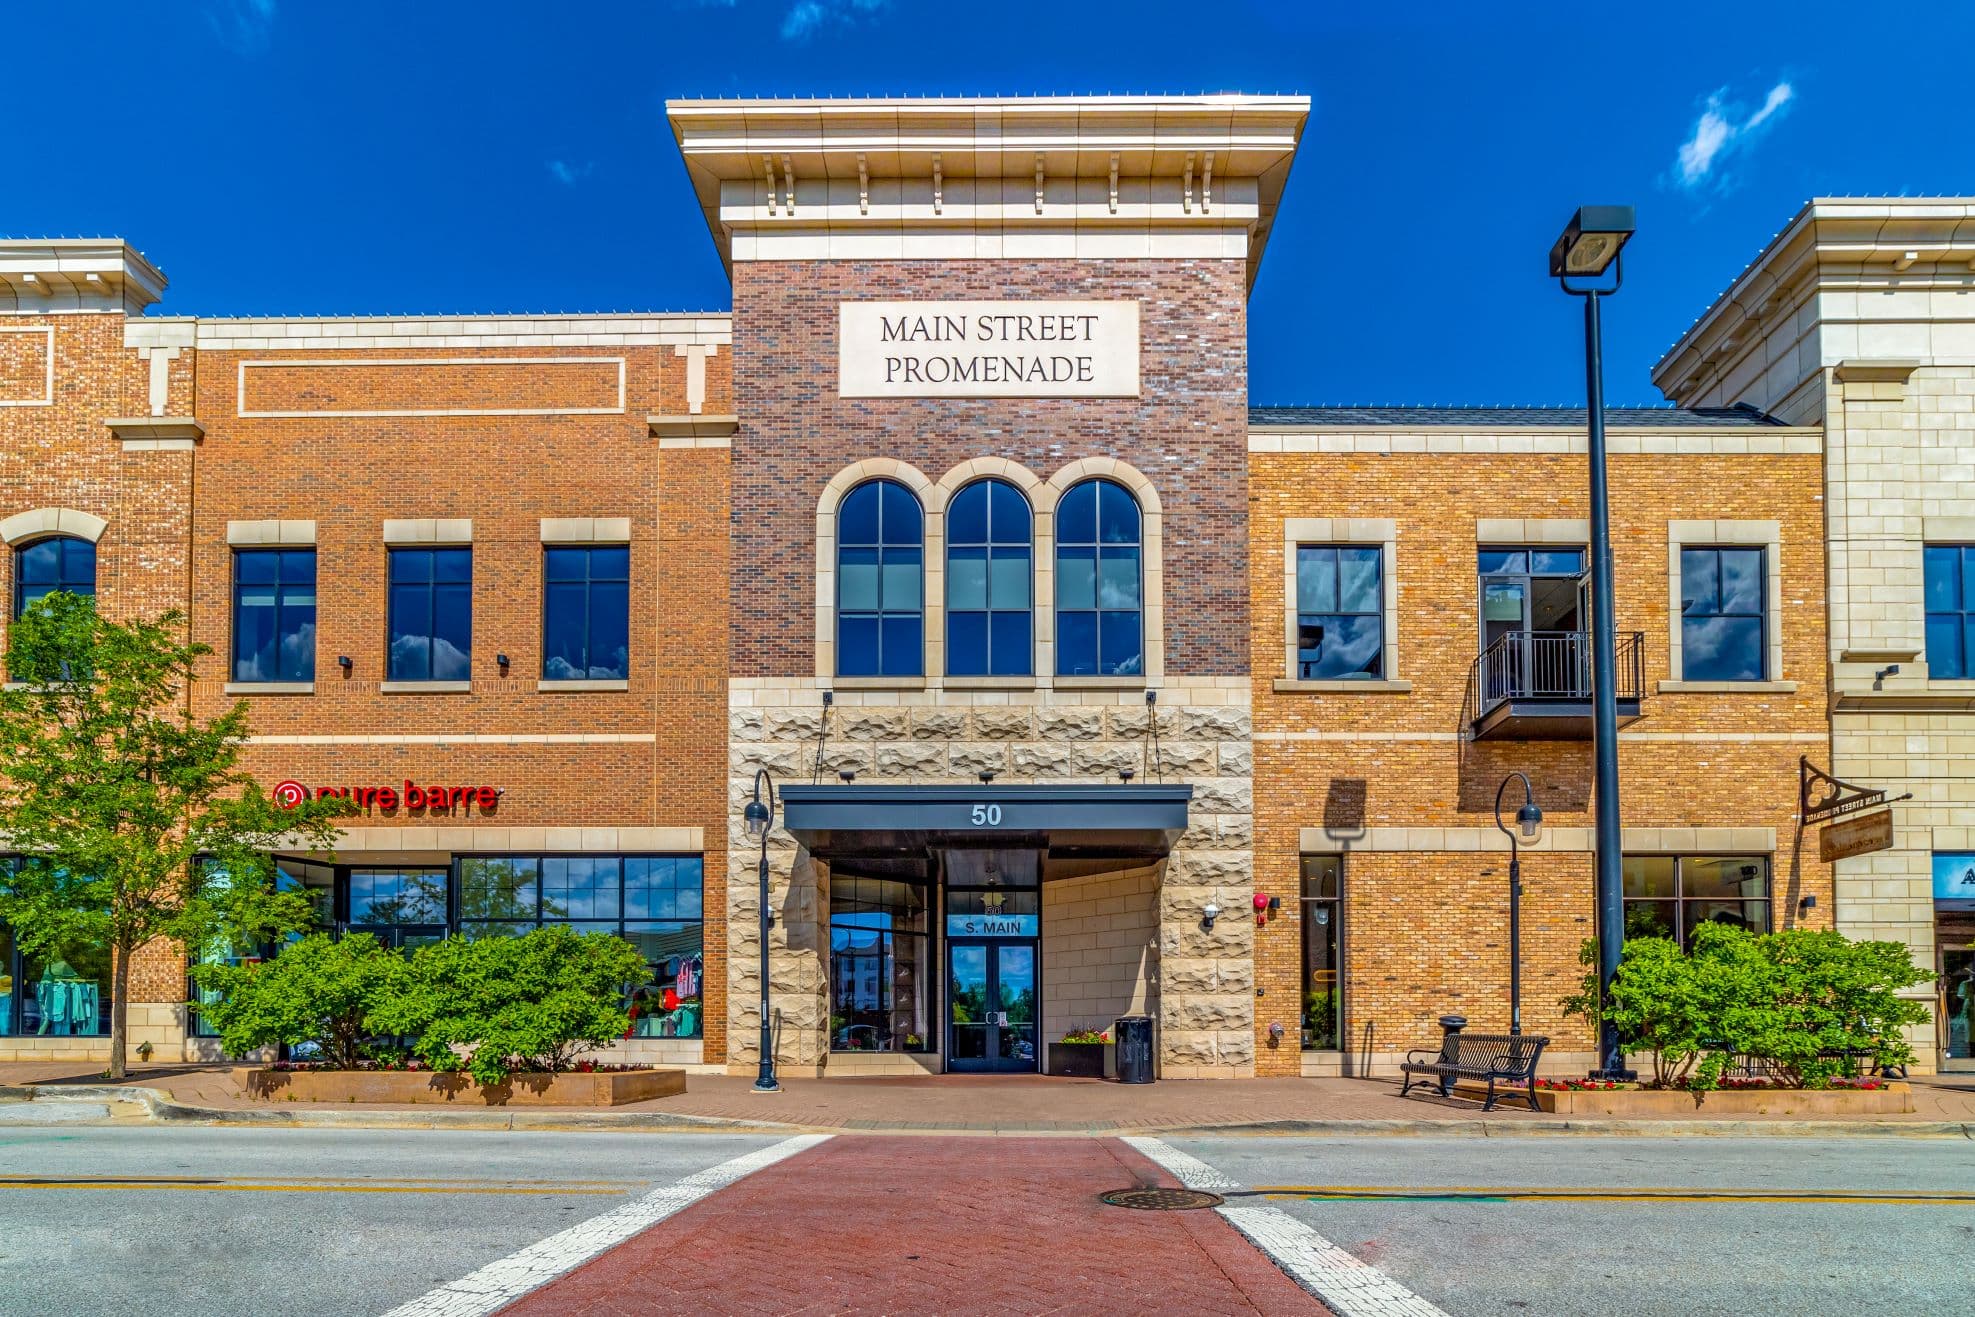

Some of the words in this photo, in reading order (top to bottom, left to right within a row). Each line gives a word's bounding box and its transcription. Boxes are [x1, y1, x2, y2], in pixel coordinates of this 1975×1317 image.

[880, 315, 967, 342] MAIN
[977, 315, 1099, 342] STREET
[884, 356, 1094, 383] PROMENADE
[404, 779, 496, 809] barre
[971, 804, 1002, 826] 50
[985, 905, 1002, 916] 50
[965, 922, 979, 934] S.
[983, 922, 1021, 934] MAIN
